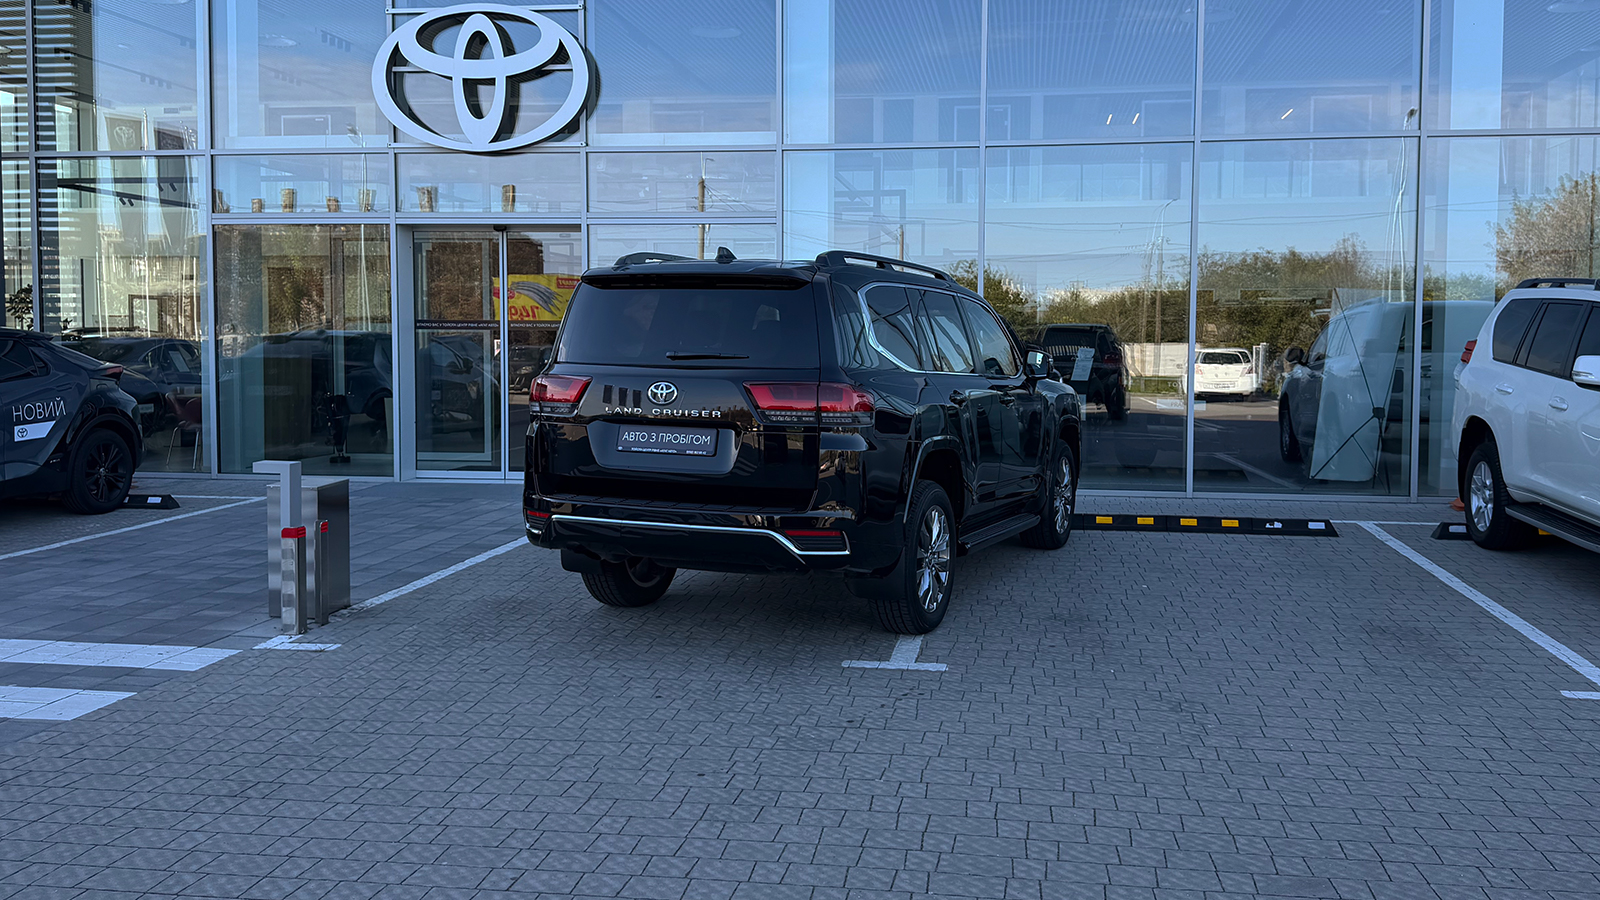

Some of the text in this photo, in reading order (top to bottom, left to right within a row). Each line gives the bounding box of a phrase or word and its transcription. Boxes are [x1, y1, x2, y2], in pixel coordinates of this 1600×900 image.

[12, 397, 66, 422] НОВИЙ
[605, 406, 721, 418] LAND CRUISER
[622, 431, 711, 445] АВТО З ПРОБІГОМ
